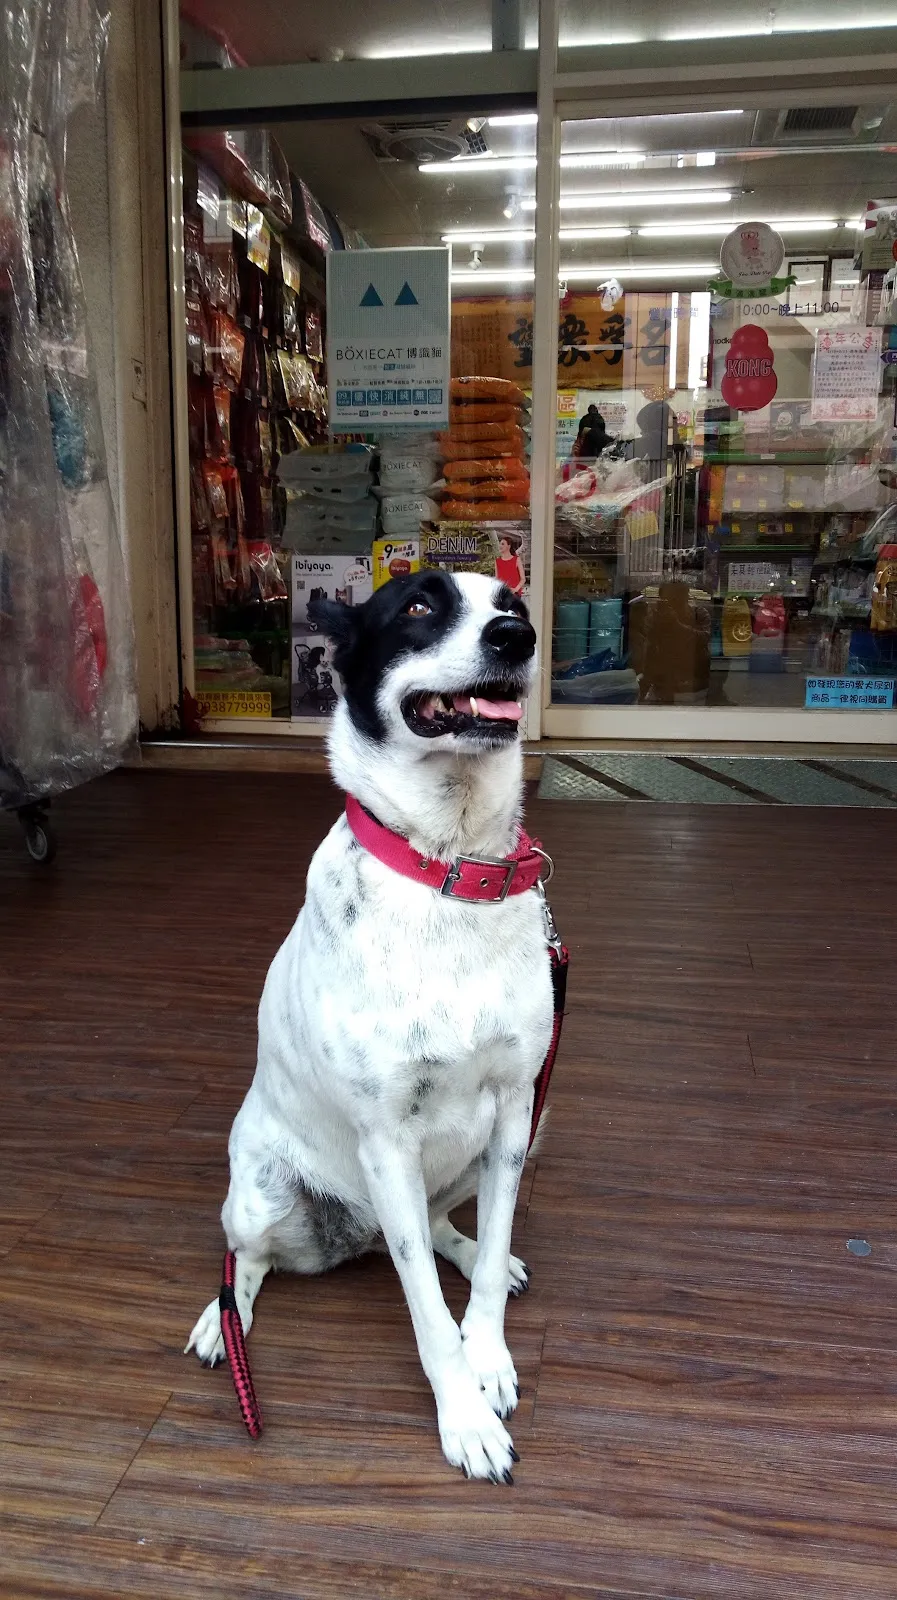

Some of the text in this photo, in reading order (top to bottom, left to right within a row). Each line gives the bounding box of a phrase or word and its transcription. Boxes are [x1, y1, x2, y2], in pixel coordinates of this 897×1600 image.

[727, 359, 771, 378] KONG
[428, 534, 477, 553] DENIM
[196, 701, 271, 713] 0938779999
